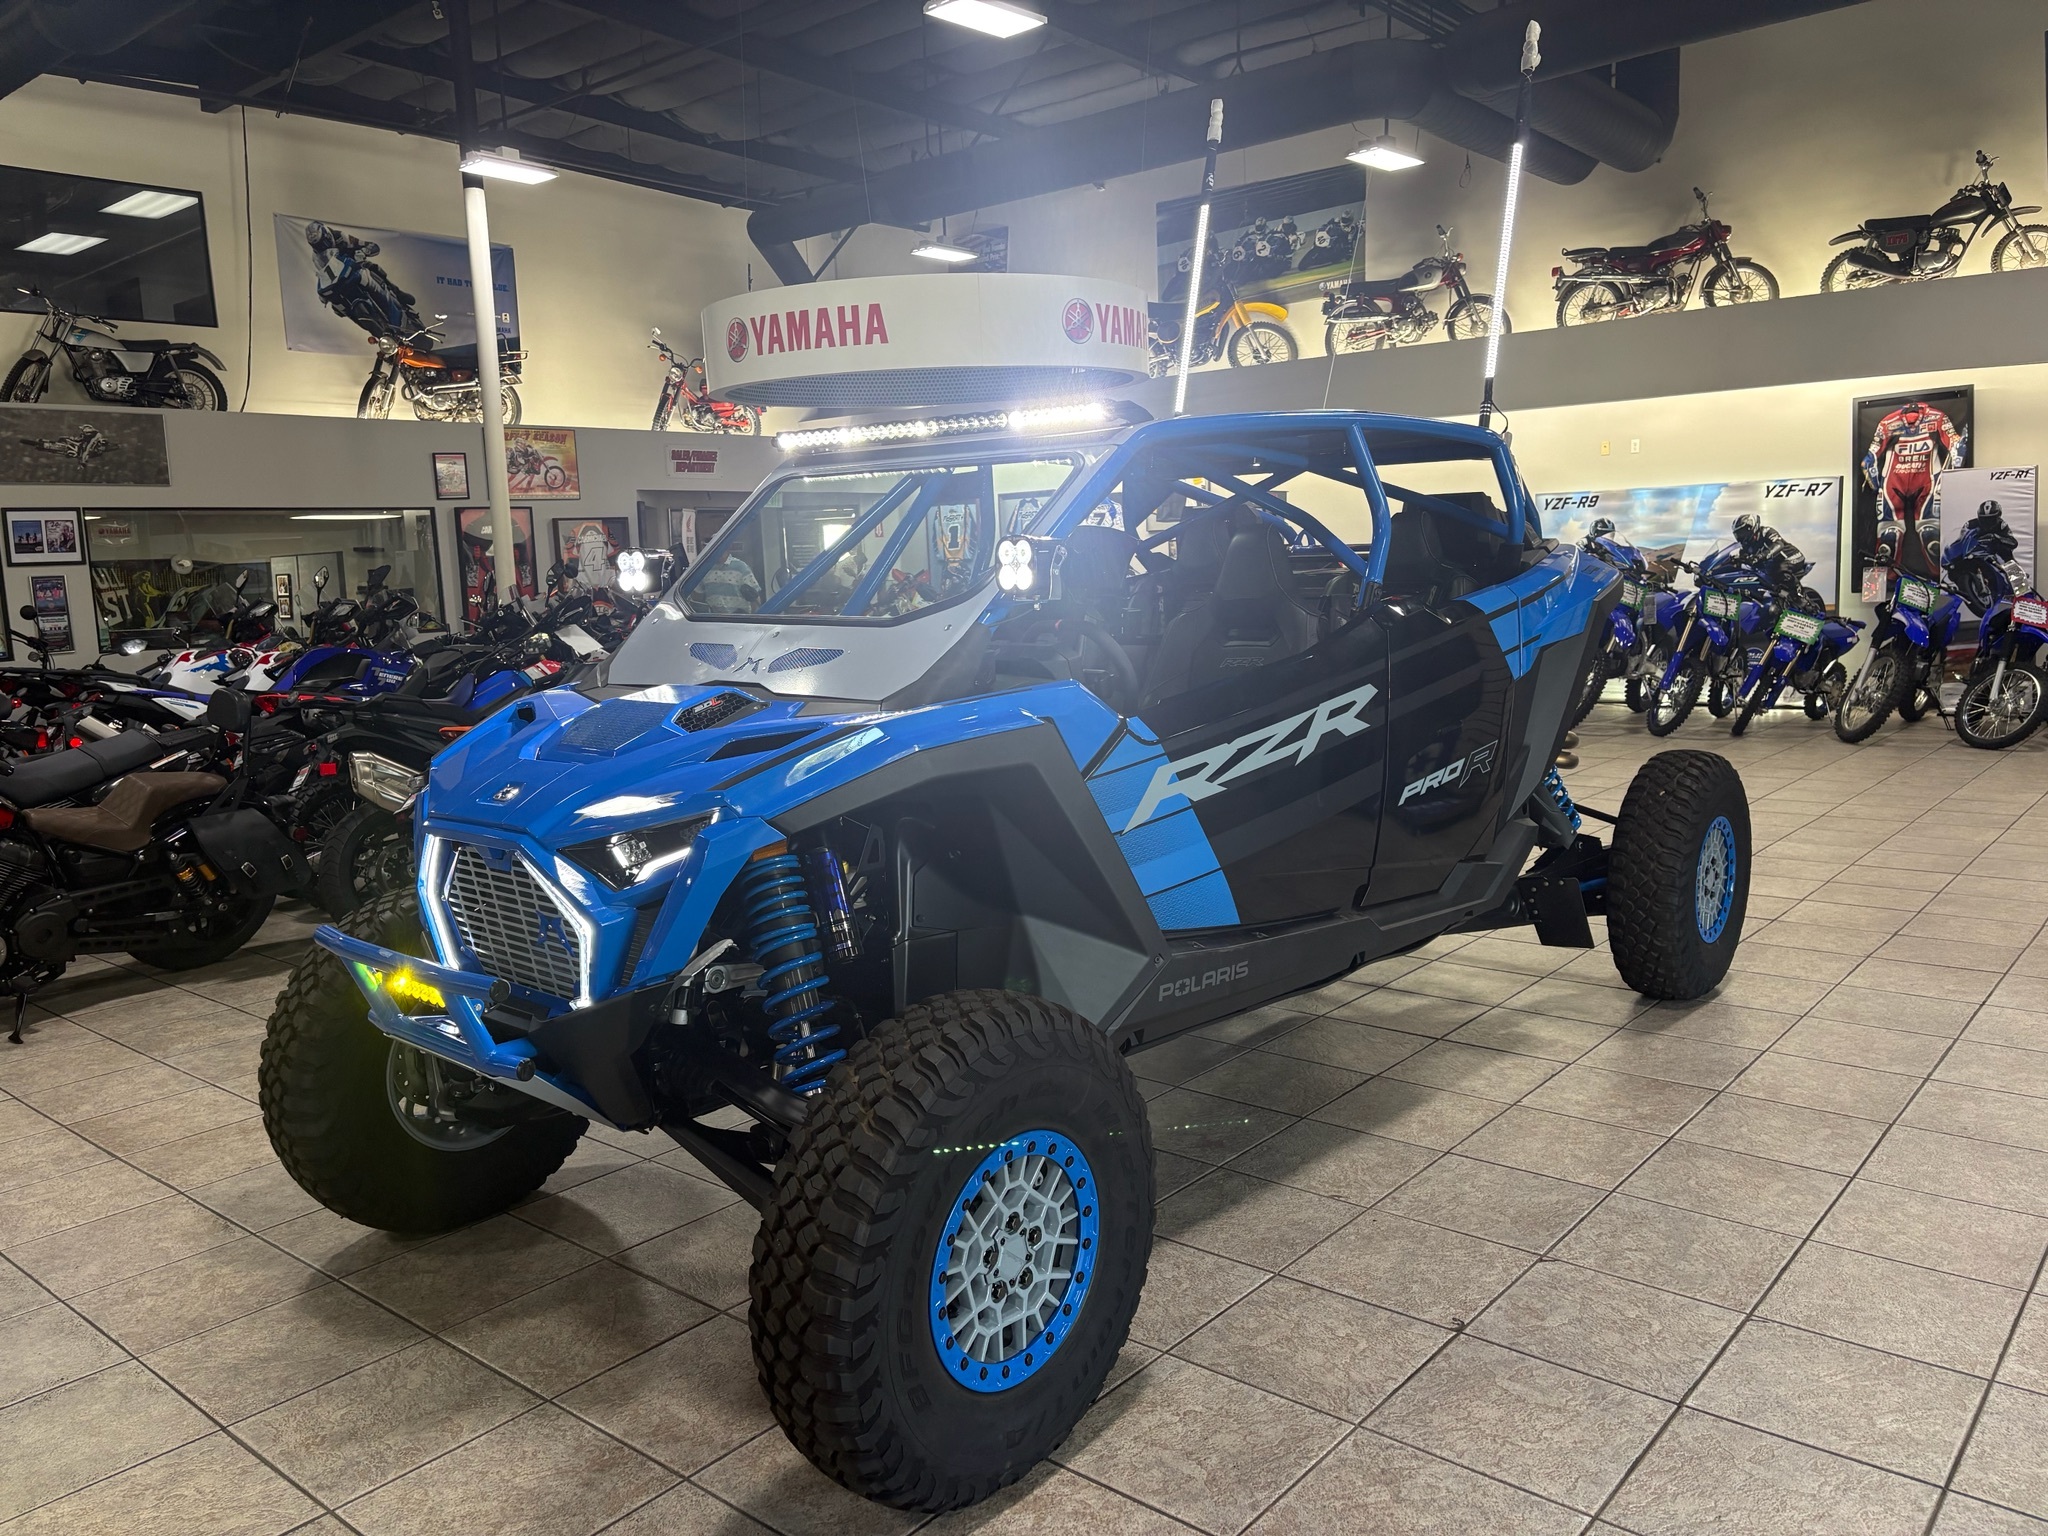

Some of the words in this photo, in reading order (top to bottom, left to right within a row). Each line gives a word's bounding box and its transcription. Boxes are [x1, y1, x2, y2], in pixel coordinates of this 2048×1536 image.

[436, 276, 446, 285] IT
[447, 278, 463, 288] HAD
[749, 303, 889, 356] YAMAHA
[532, 432, 568, 445] SEASON
[1898, 441, 1931, 454] FILA
[1898, 455, 1928, 463] BREIL
[1989, 469, 2030, 481] YZF-R1
[1764, 482, 1833, 499] YZF-R7
[1543, 495, 1600, 511] YZF-R9
[948, 524, 961, 550] 1
[584, 546, 606, 572] 4
[1121, 683, 1379, 836] RZR
[1398, 757, 1466, 807] PRO
[1458, 739, 1499, 789] R
[1159, 961, 1249, 1002] POLARIS
